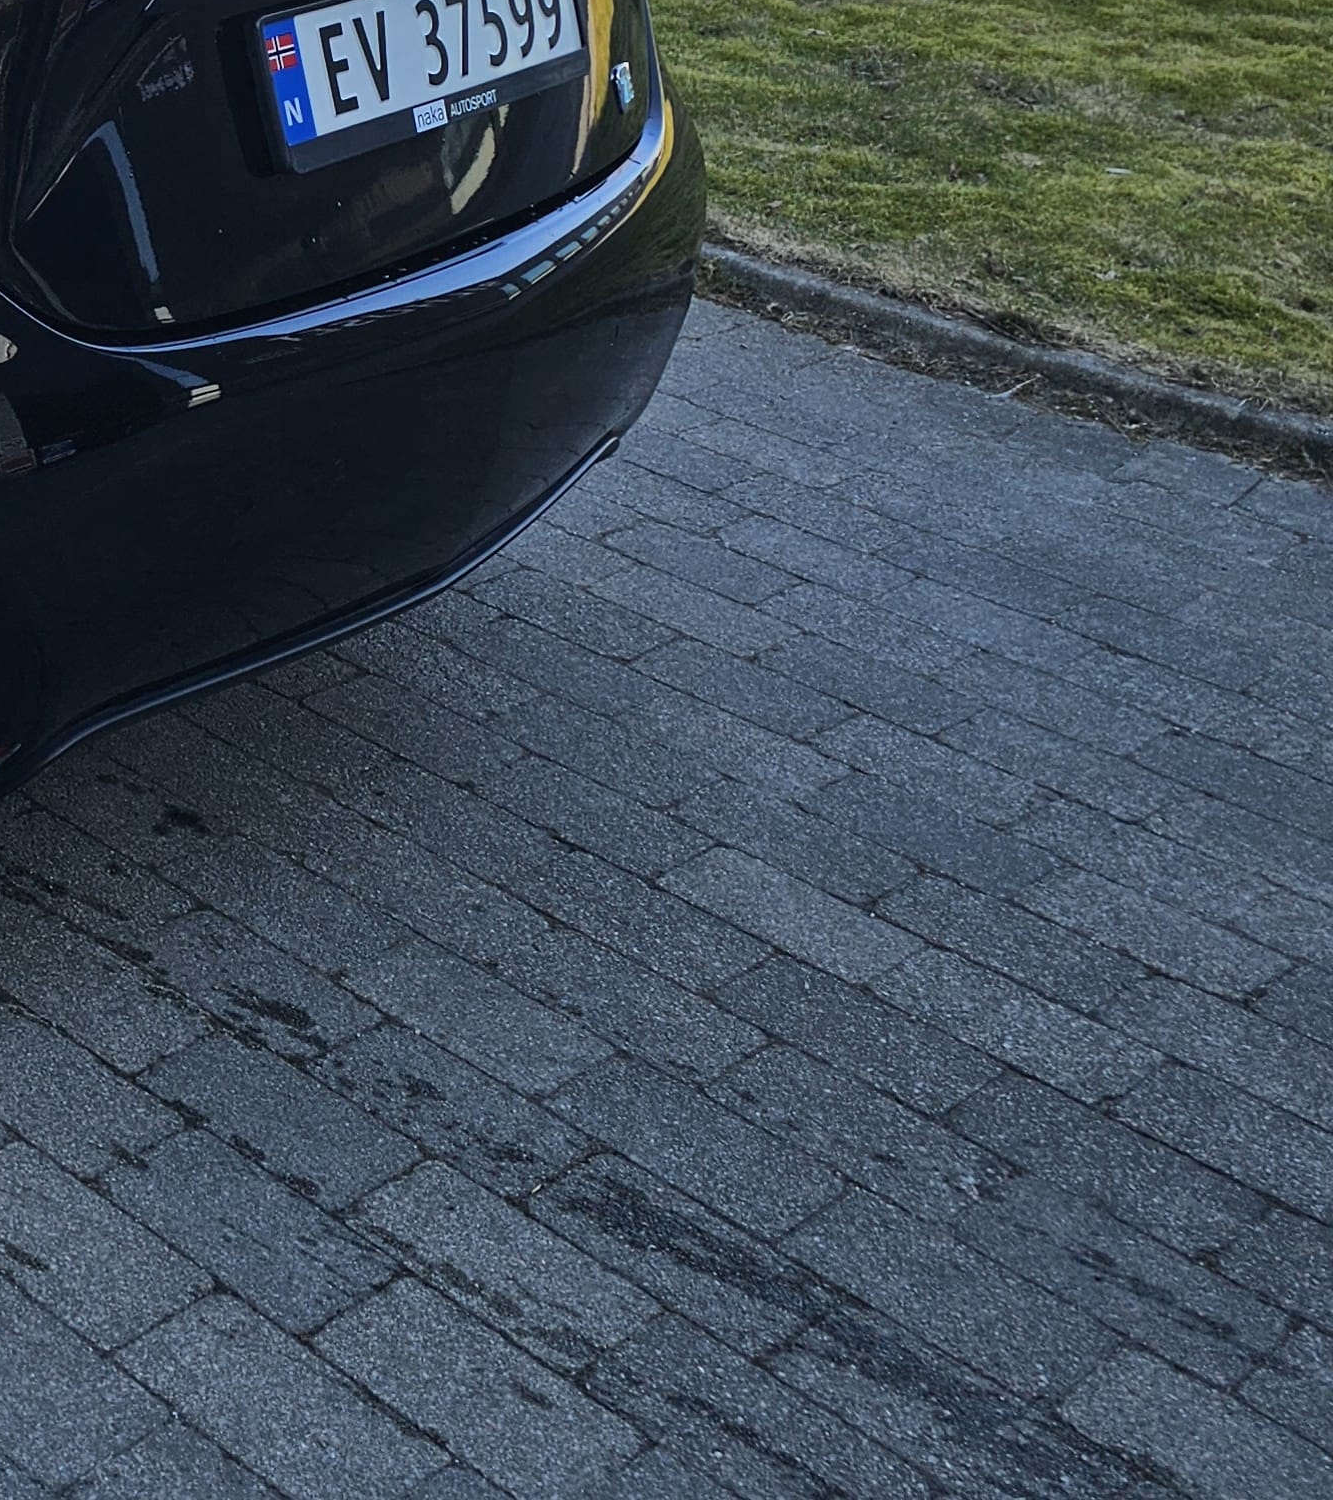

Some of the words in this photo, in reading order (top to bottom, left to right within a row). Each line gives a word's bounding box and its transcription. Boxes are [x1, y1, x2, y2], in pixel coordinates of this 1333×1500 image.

[318, 10, 390, 116] EV
[284, 98, 304, 127] N
[417, 106, 445, 127] naka
[450, 88, 498, 117] AUTOSPORT
